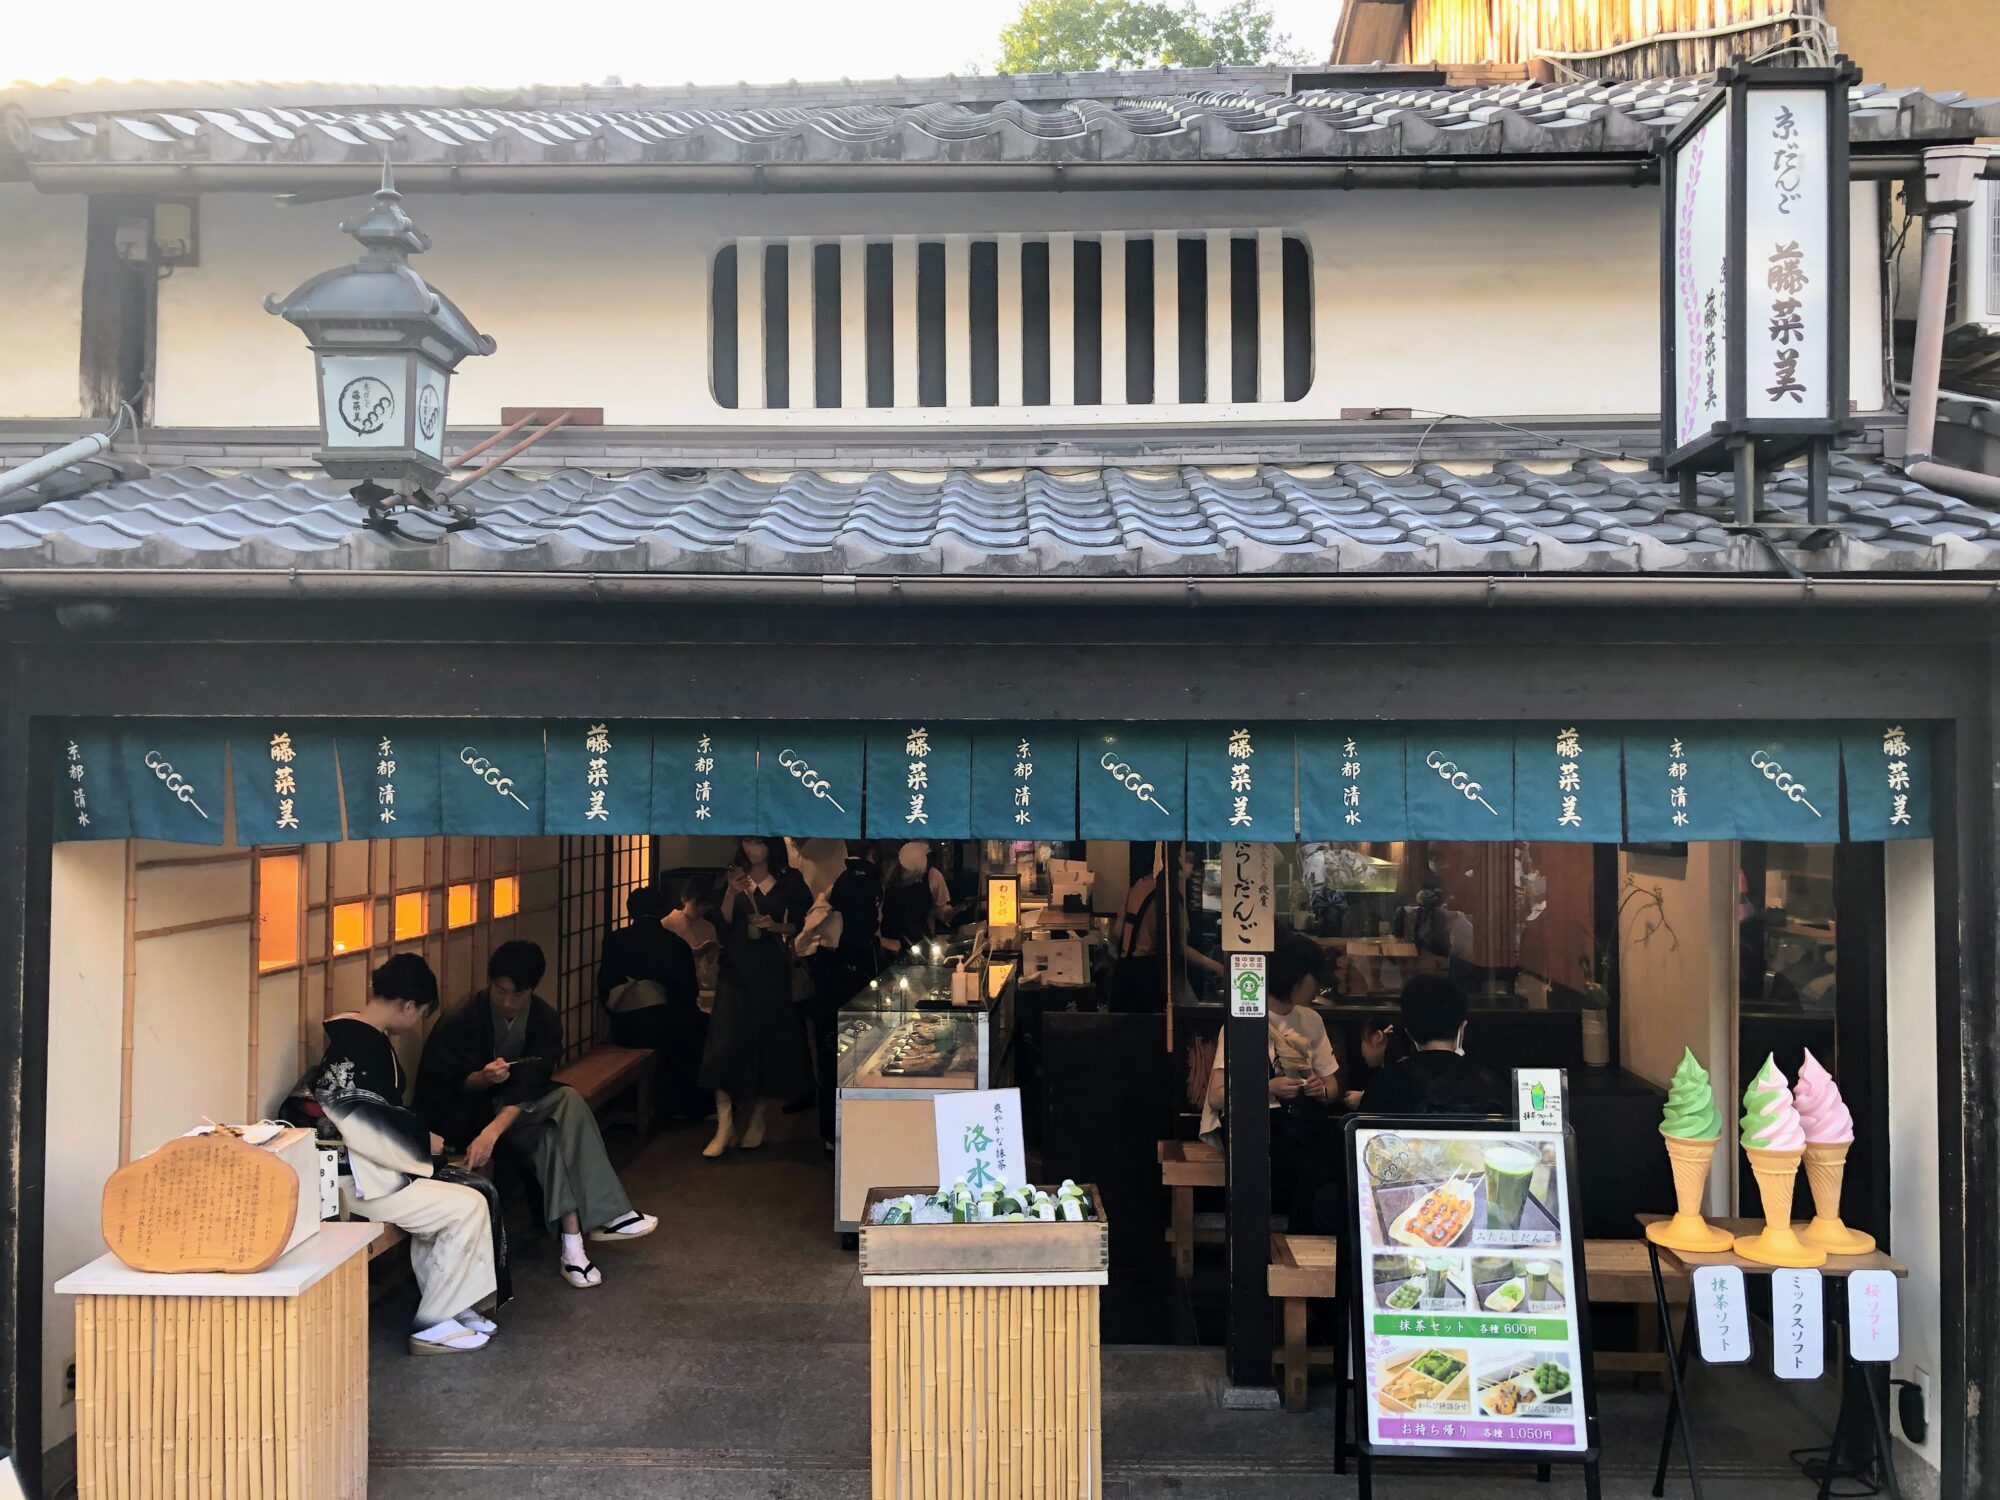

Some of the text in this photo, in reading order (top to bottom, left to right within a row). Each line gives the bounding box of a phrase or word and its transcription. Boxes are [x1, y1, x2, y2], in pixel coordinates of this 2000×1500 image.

[1772, 105, 1802, 215] 京だんご
[1765, 240, 1809, 404] 藤菜美
[67, 740, 90, 827] 京都清水
[269, 732, 299, 830] 藤菜美
[376, 736, 396, 824] 京都清水
[585, 723, 611, 822] 藤菜美
[694, 733, 714, 821] 京都清水
[904, 727, 931, 825] 藤菜美
[1013, 737, 1033, 826] 京都清水
[1228, 728, 1255, 827] 藤菜美
[1340, 737, 1361, 826] 京都清水
[1556, 727, 1583, 828] 藤菜美
[1667, 737, 1690, 827] 京都清水
[1883, 726, 1911, 826] 藤菜美
[963, 1124, 996, 1189] 洛水
[993, 1103, 1007, 1171] 爽やかな抹茶
[1476, 1232, 1552, 1243] みたらしだんご
[1398, 1319, 1537, 1335] 抹茶セット 各種 600円
[1711, 1277, 1730, 1351] 抹茶ソフト
[1791, 1276, 1806, 1370] ミックスソフト
[1865, 1285, 1880, 1340] 桜ソフト
[1402, 1423, 1552, 1440] お持ち帰り 各種 1,050円
